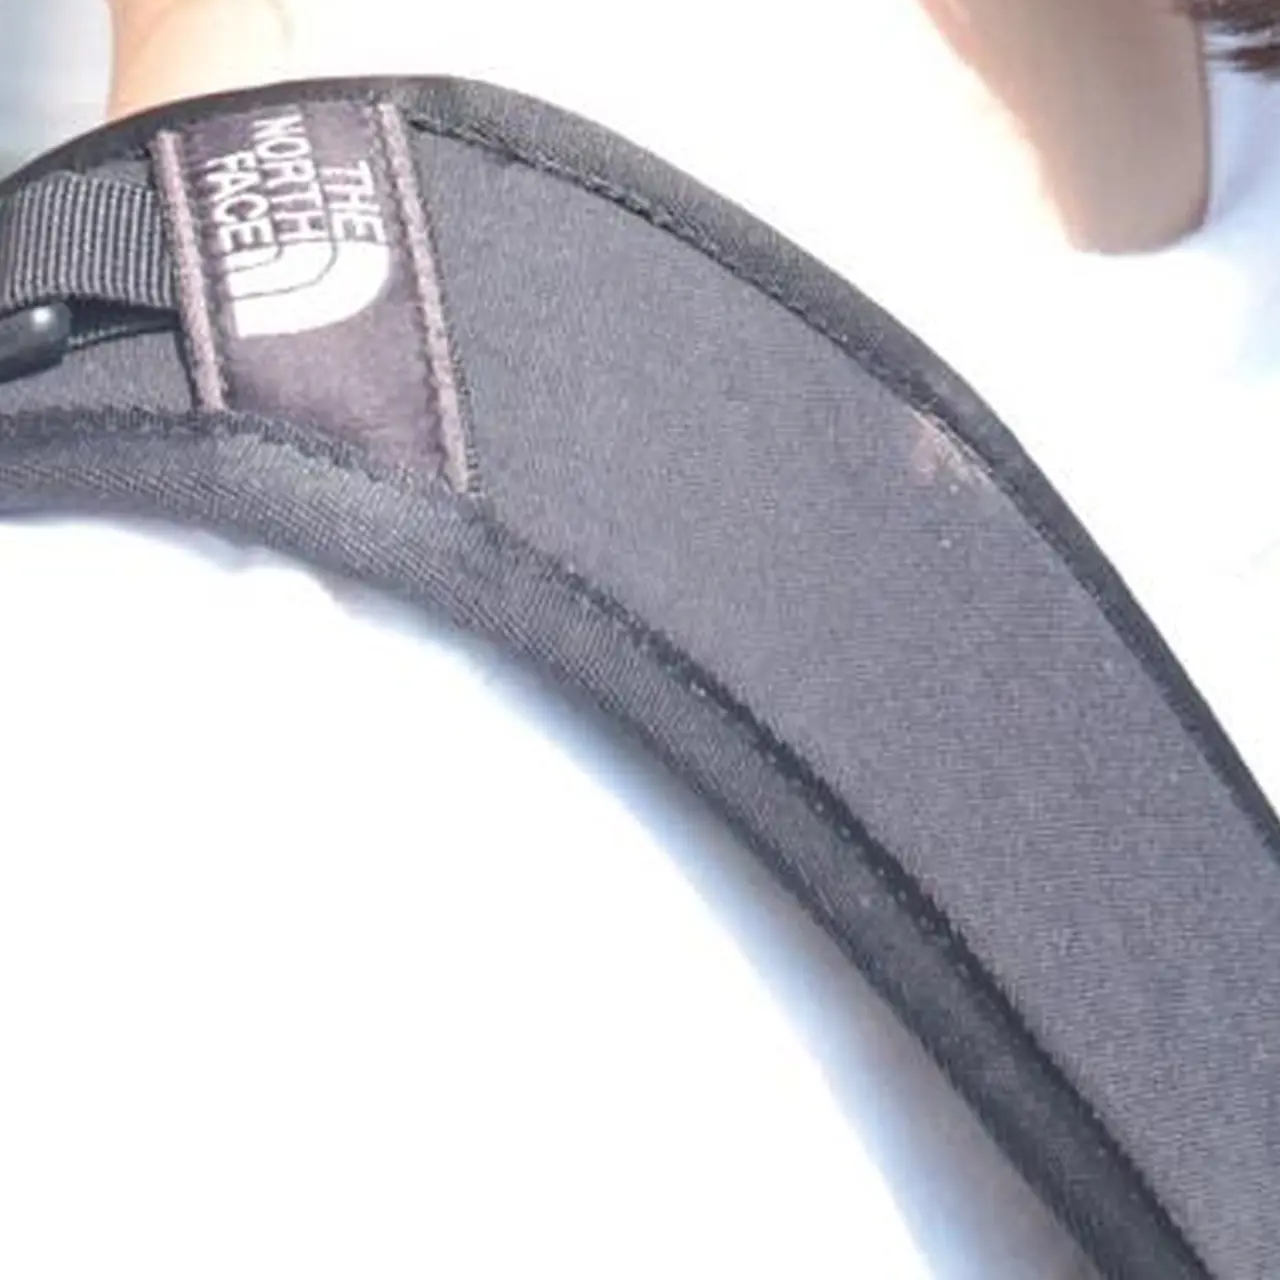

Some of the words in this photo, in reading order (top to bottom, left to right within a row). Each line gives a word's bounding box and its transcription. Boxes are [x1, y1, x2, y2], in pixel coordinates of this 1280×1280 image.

[207, 151, 275, 254] FACE
[253, 114, 327, 242] NORTH
[321, 159, 388, 244] THE
